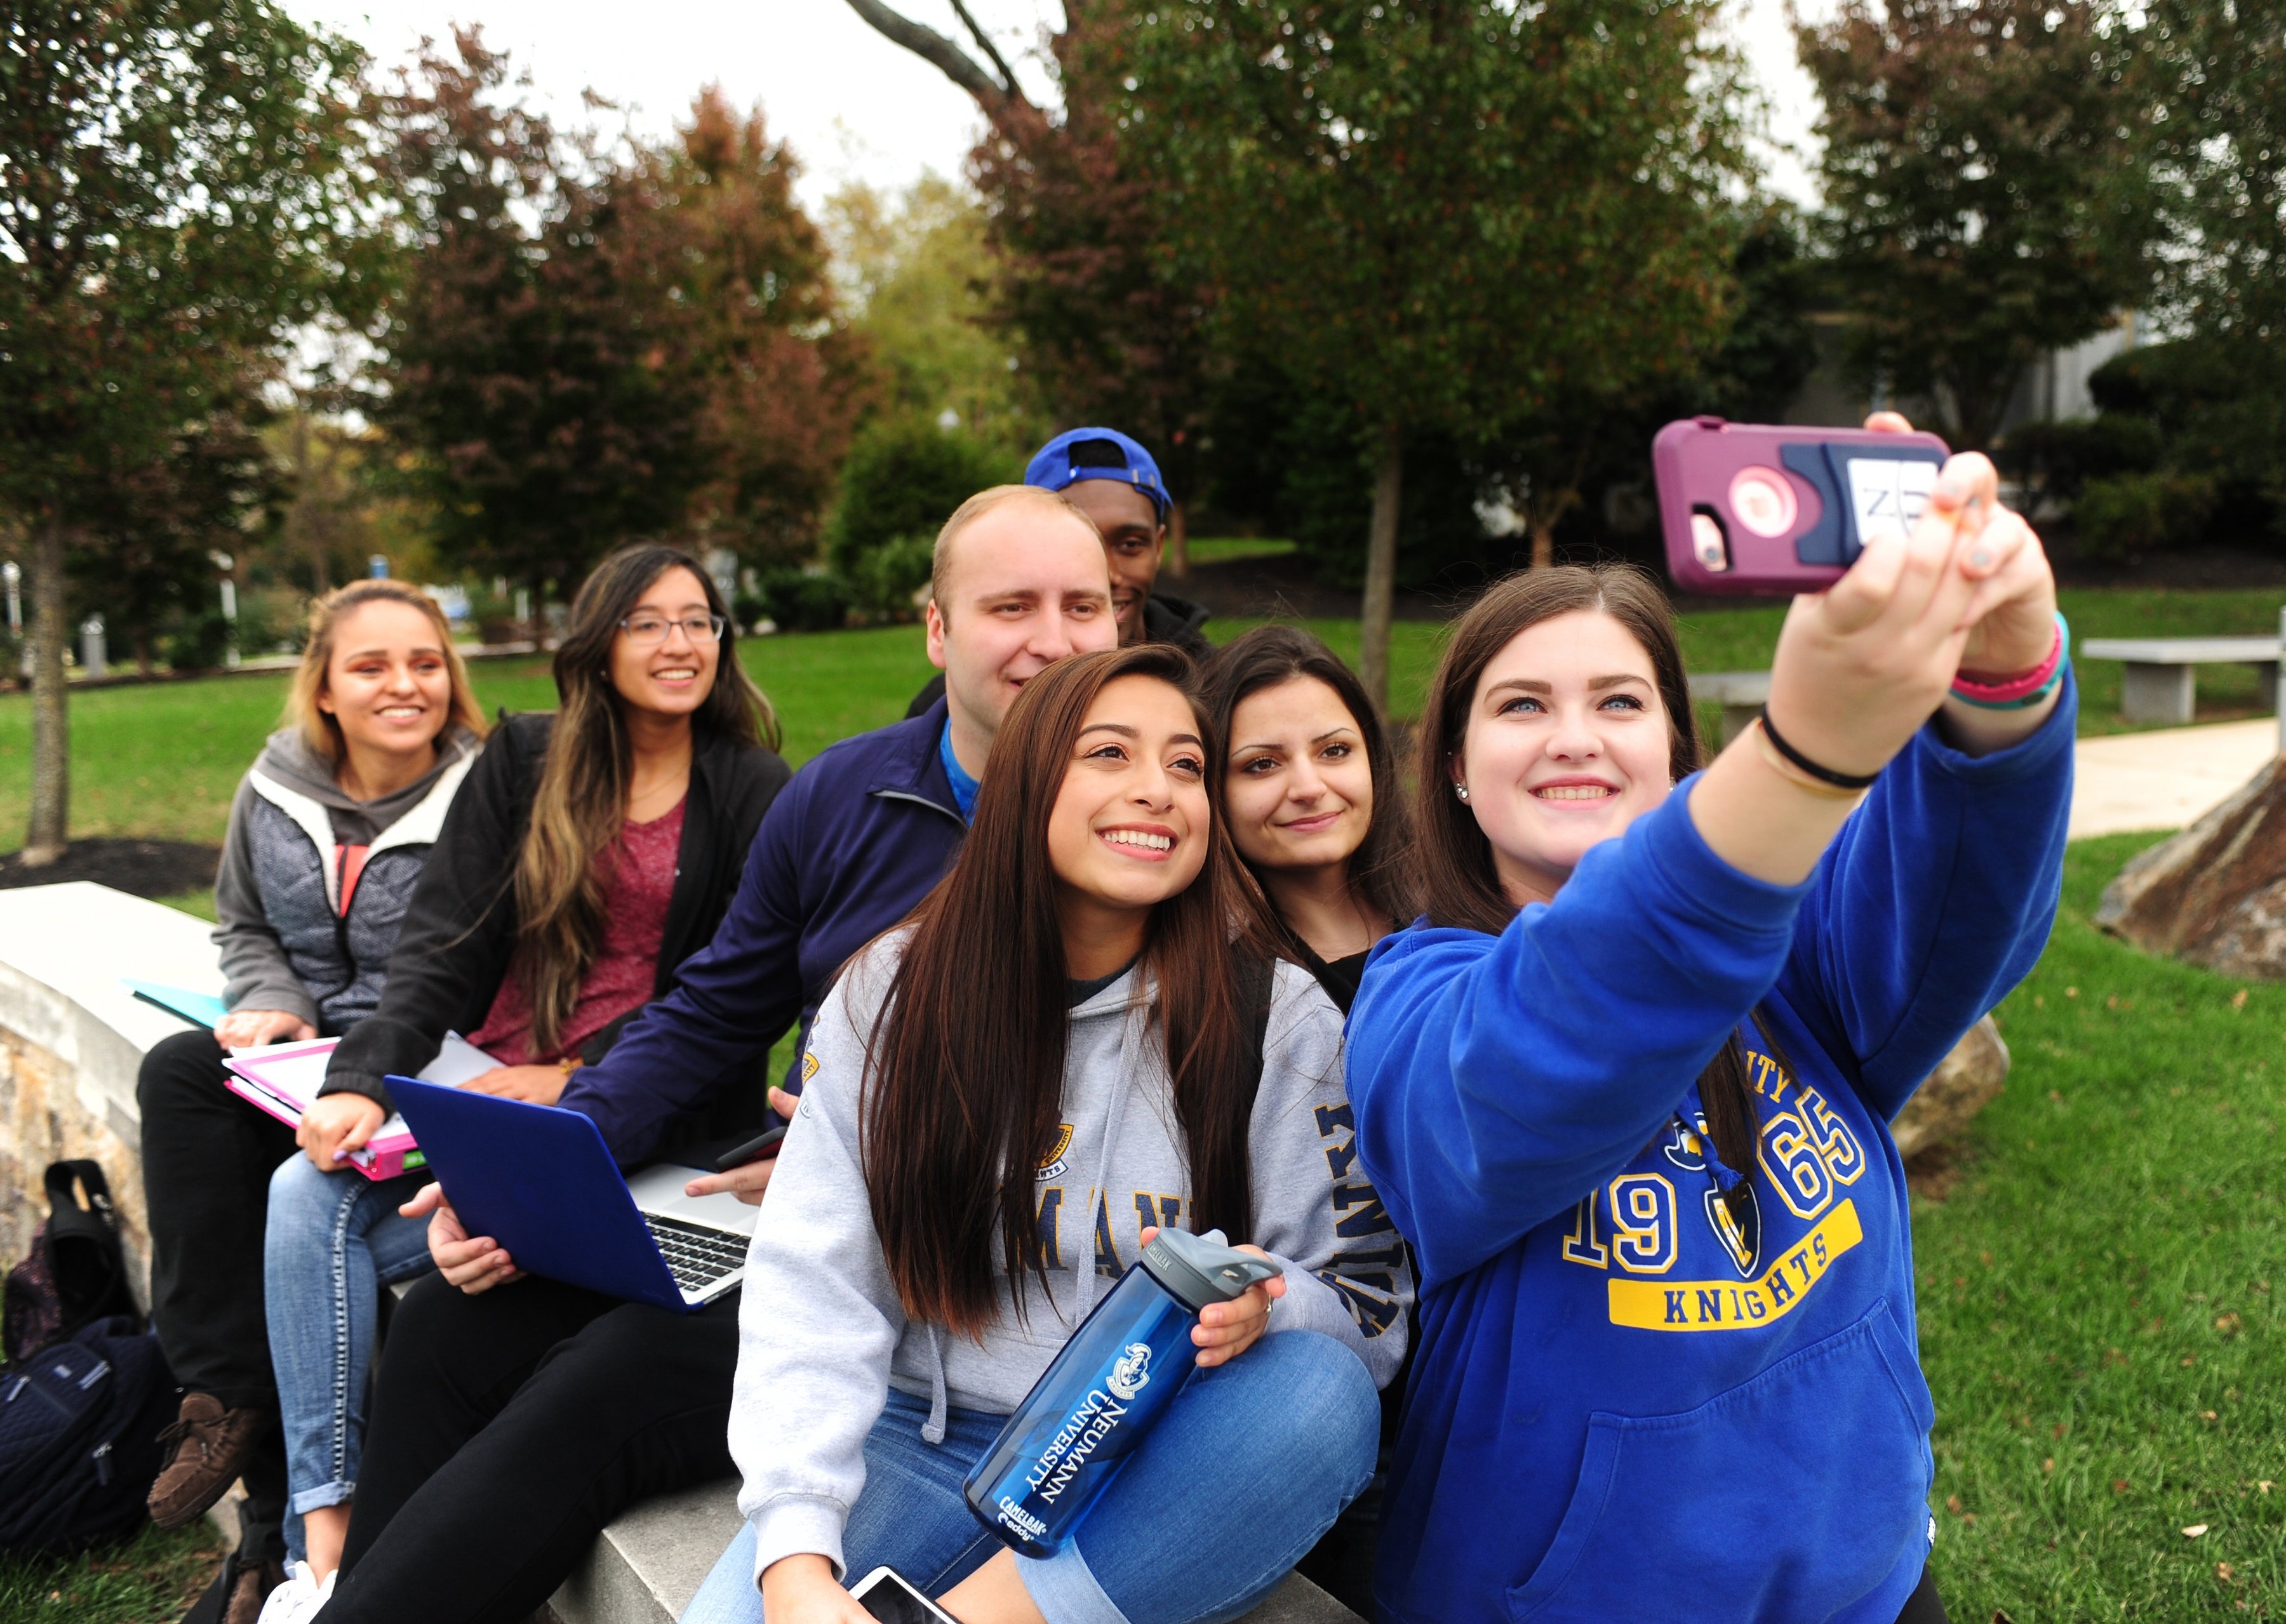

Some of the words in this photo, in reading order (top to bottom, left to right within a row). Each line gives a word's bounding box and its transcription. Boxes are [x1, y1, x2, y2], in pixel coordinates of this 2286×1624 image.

[1664, 1232, 1828, 1324] KNIGHTS
[1025, 1388, 1110, 1492] UNIVERSITY
[1040, 1398, 1128, 1504] NEUMANN
